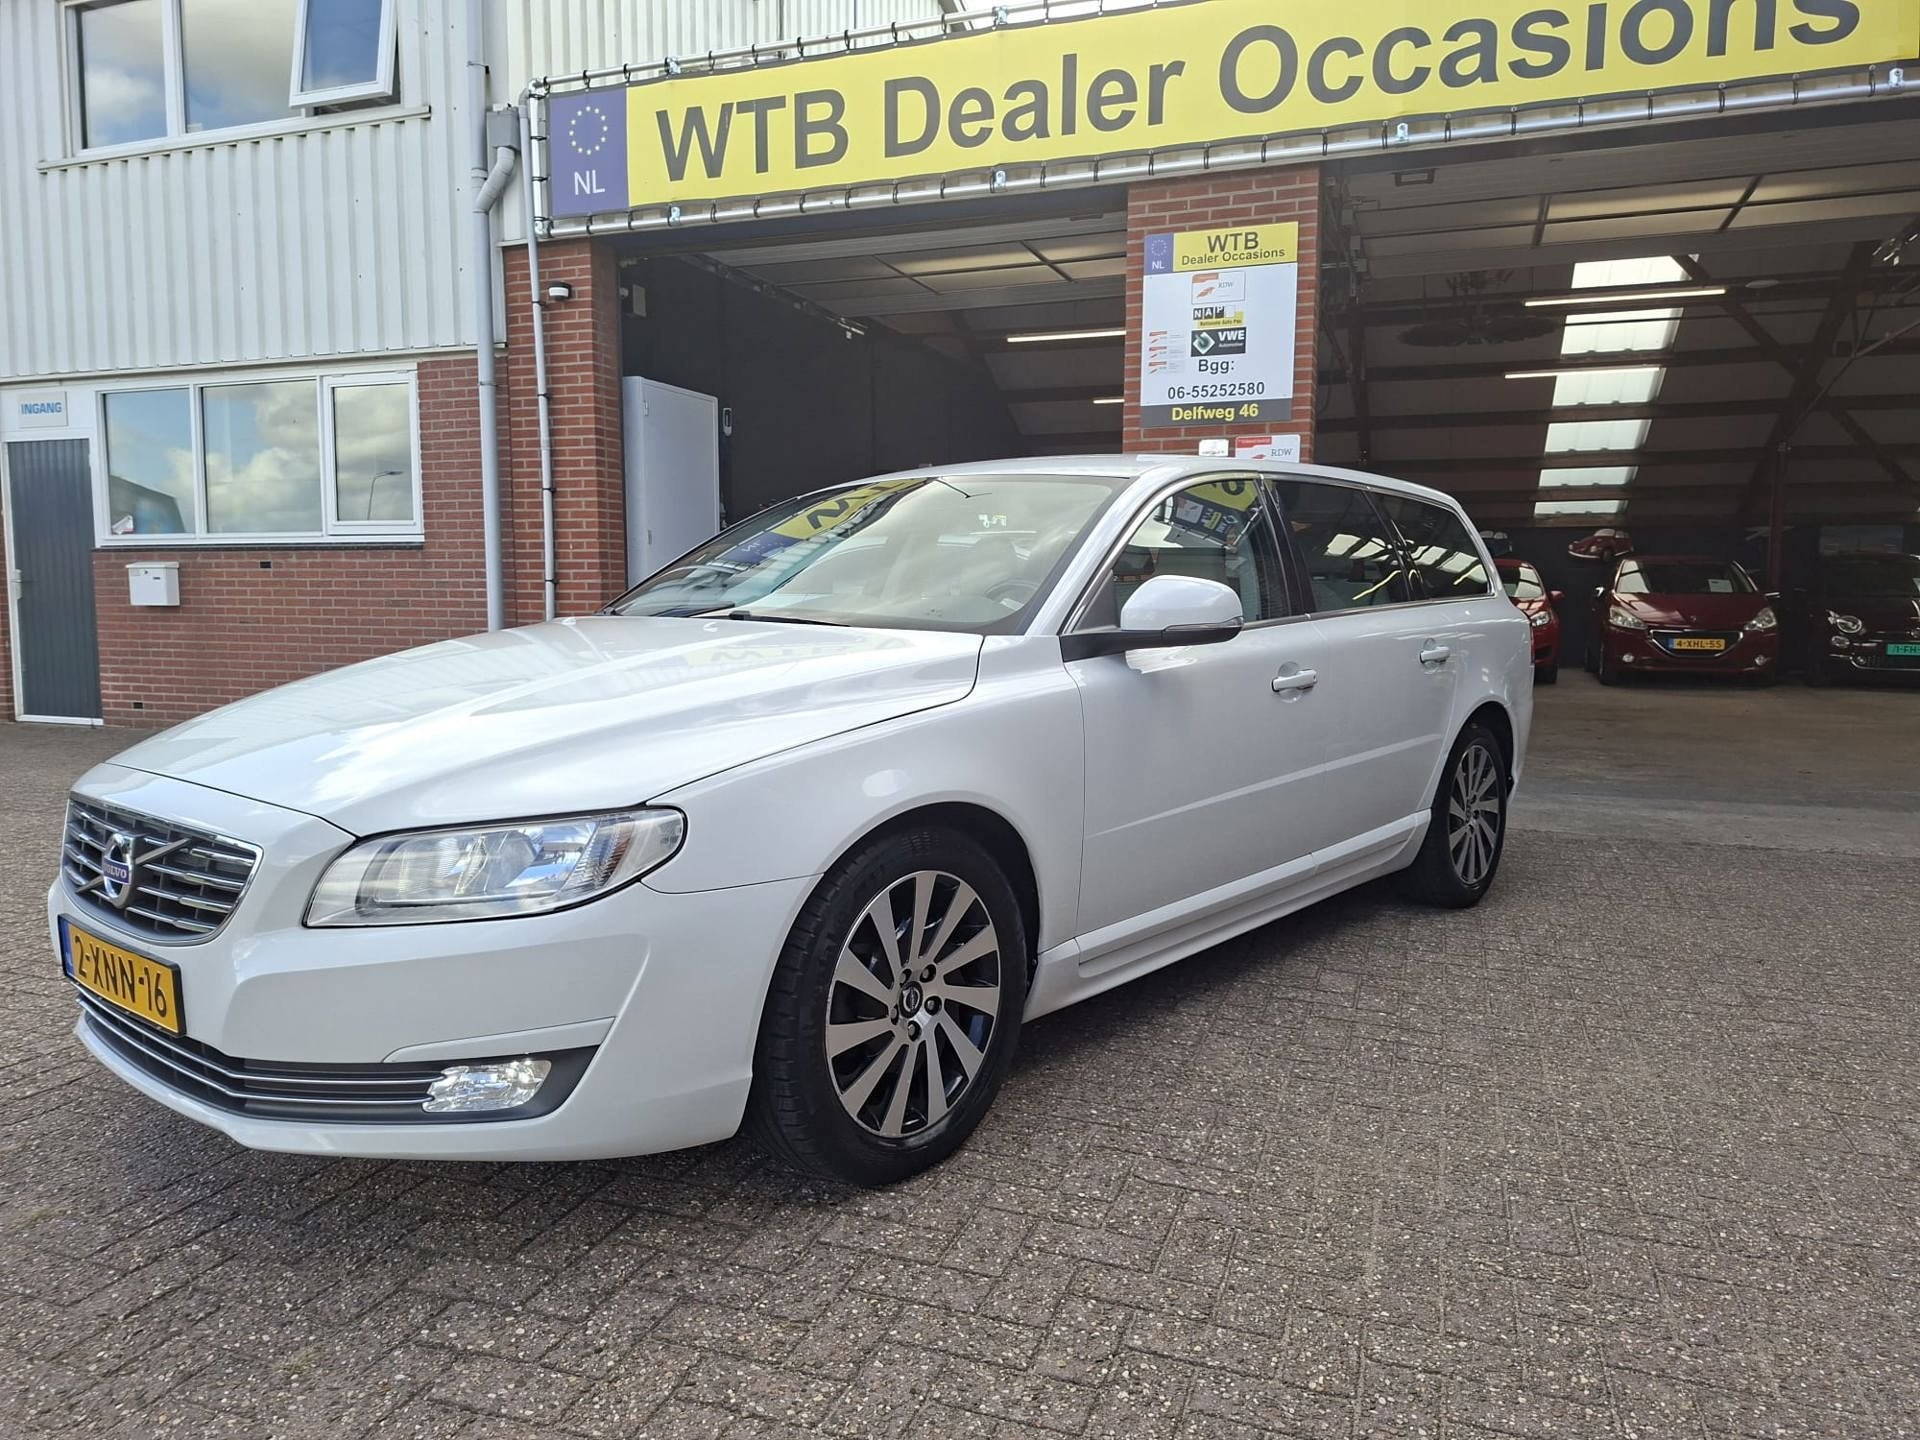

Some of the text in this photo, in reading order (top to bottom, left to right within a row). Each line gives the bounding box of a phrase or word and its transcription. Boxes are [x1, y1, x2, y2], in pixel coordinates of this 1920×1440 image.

[656, 0, 1860, 182] WTB Dealer Occasions
[573, 169, 605, 195] NL
[1207, 231, 1259, 253] WTB
[1152, 260, 1165, 270] NL
[1181, 248, 1285, 266] Dealer Occasions
[1194, 304, 1224, 318] NAP
[1218, 330, 1244, 341] VWE
[1198, 359, 1234, 374] Bgg:
[1168, 382, 1265, 400] 06-55252580
[20, 402, 62, 415] INGANG
[1172, 403, 1259, 422] Delfweg 46
[1271, 448, 1293, 457] RDW
[104, 863, 127, 878] OLVO
[74, 935, 167, 1018] 2-XNN-16
